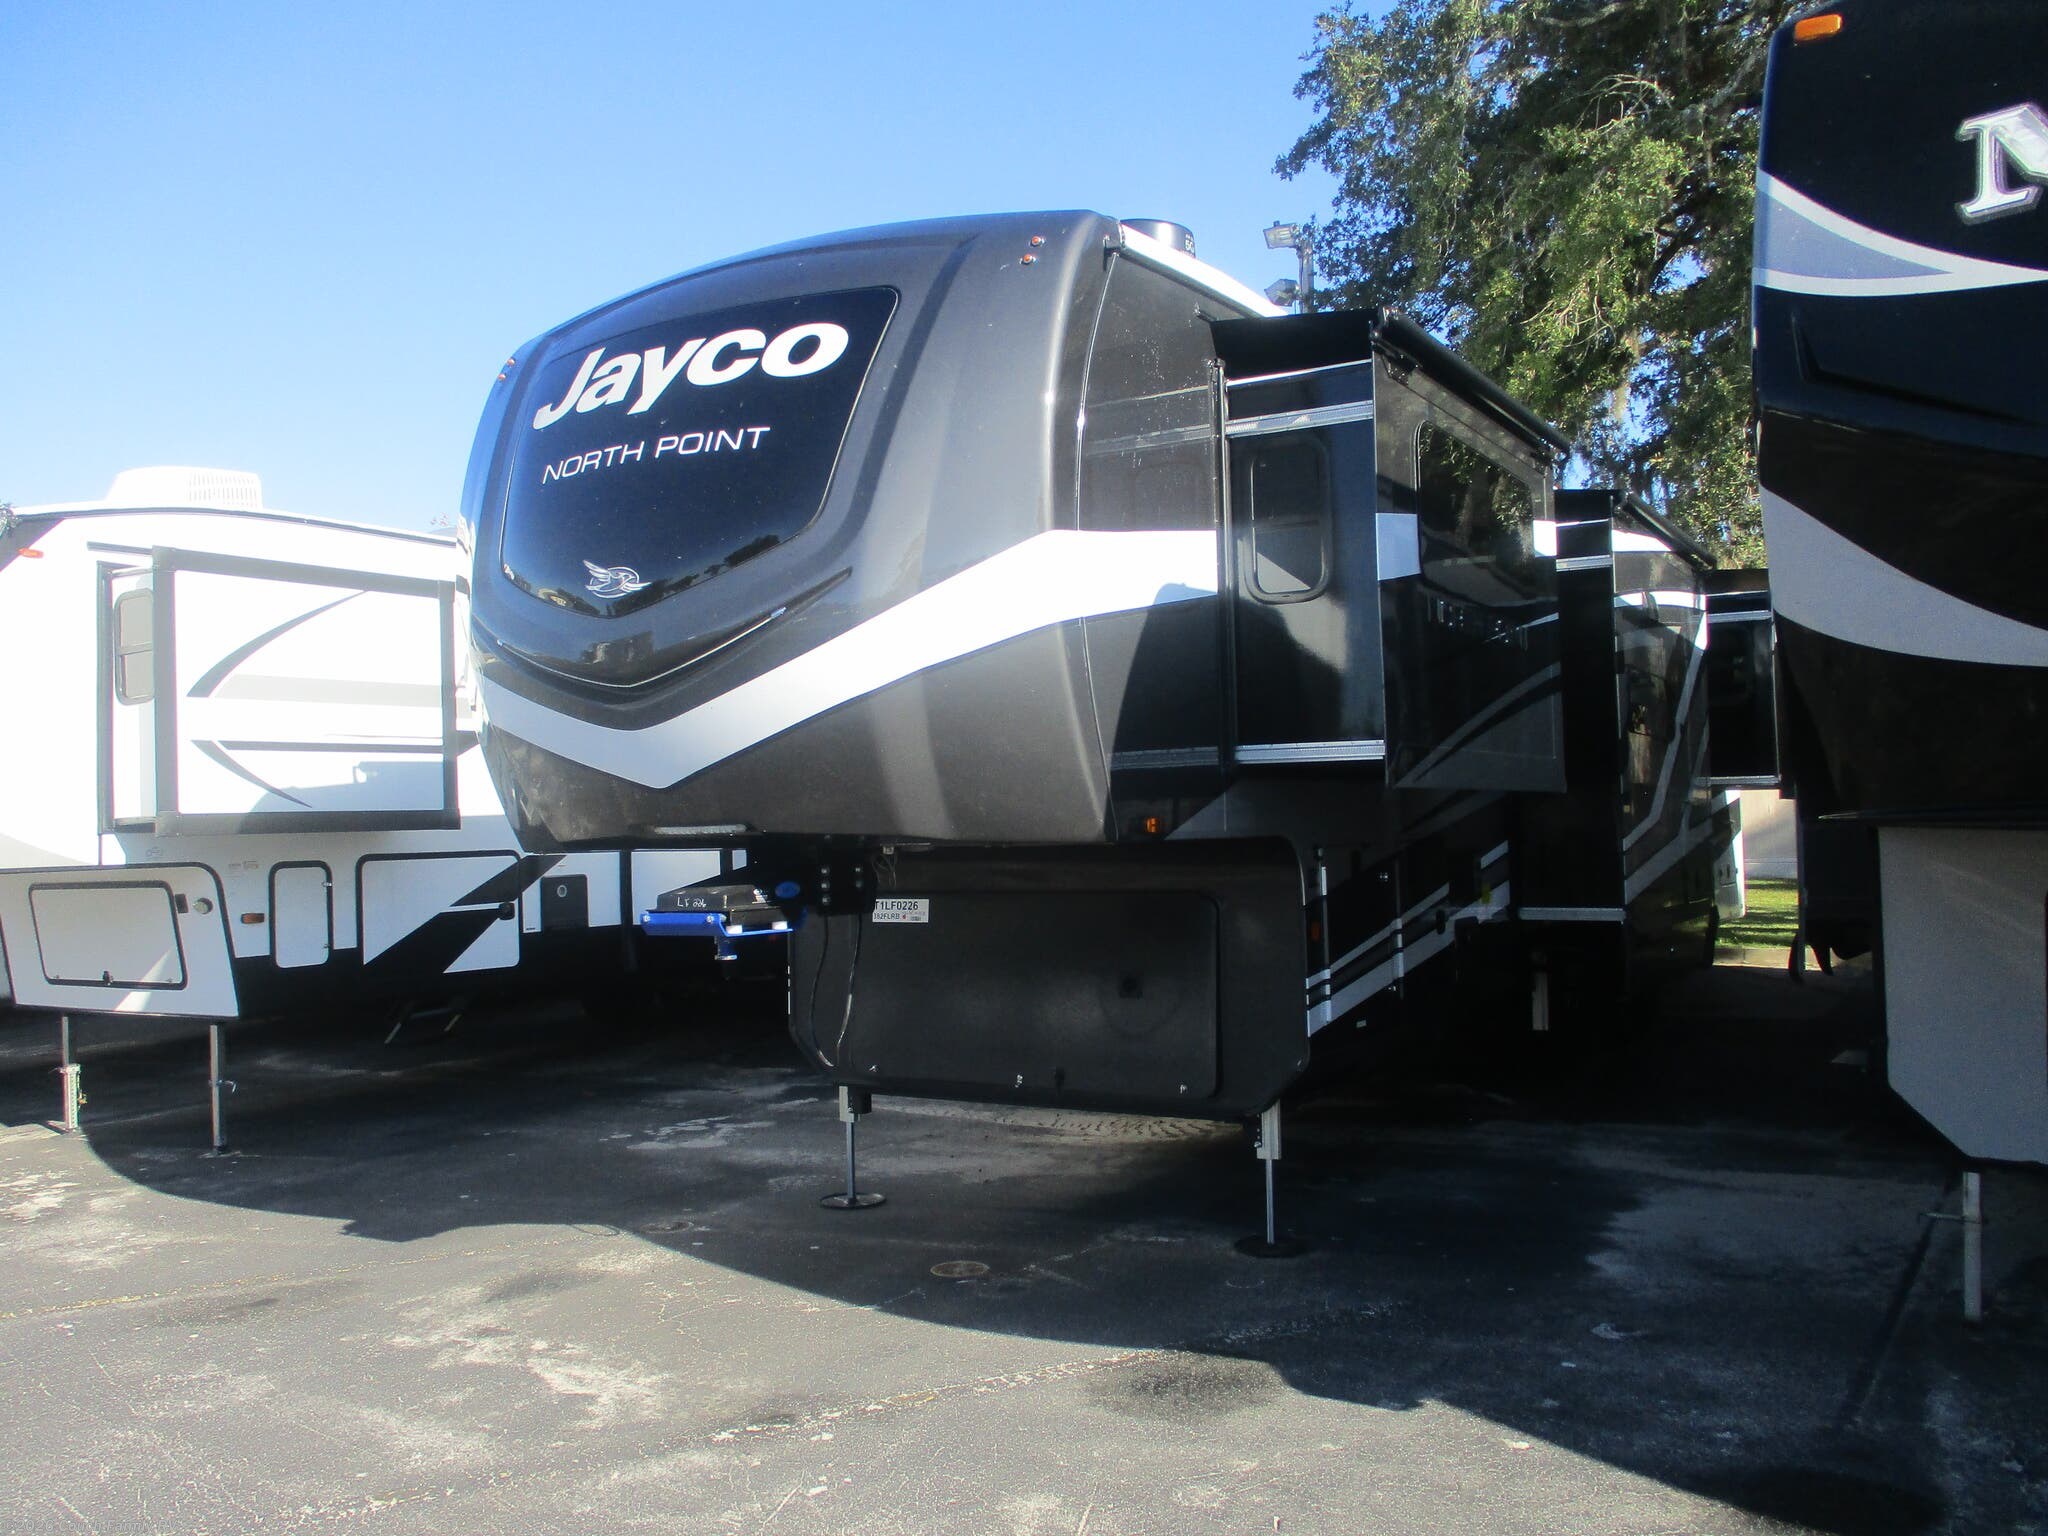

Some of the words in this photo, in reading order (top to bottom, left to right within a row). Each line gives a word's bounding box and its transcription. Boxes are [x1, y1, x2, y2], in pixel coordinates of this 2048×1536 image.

[533, 322, 849, 430] Jayco
[542, 441, 645, 484] NORTH
[655, 427, 770, 458] POINT
